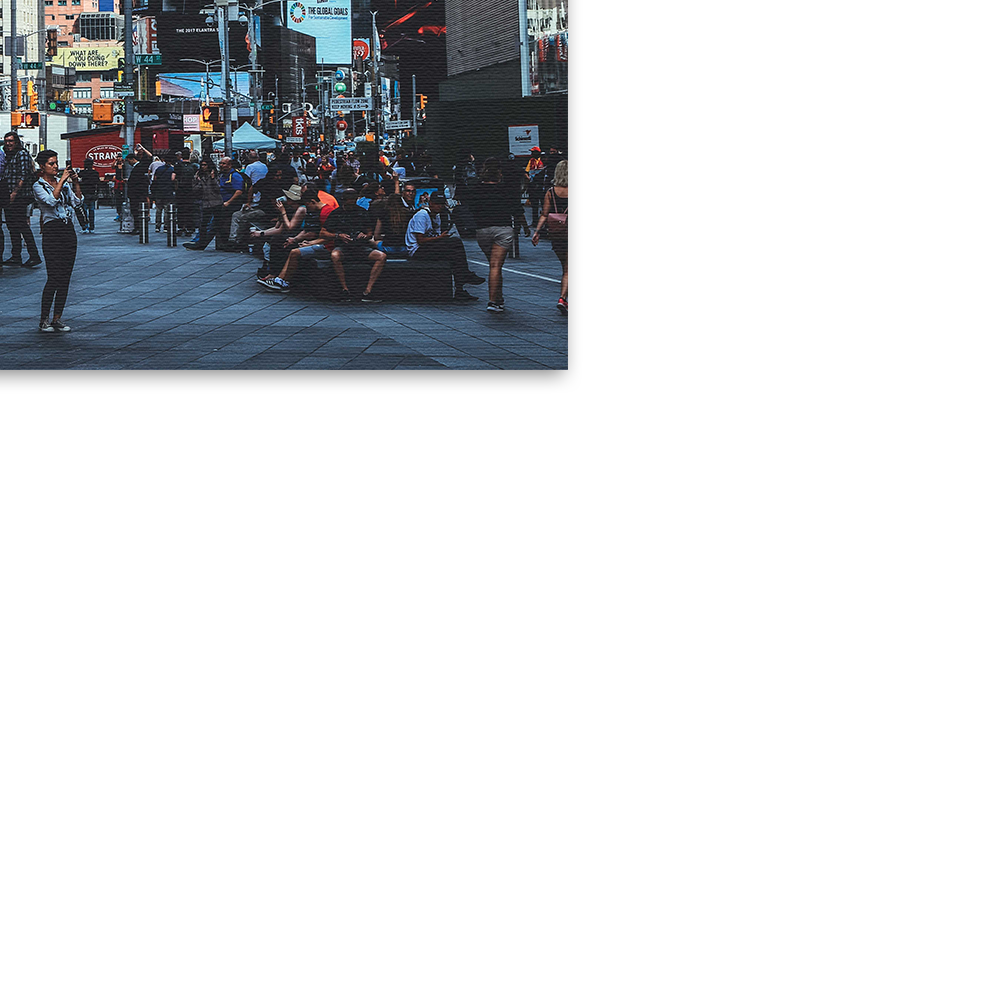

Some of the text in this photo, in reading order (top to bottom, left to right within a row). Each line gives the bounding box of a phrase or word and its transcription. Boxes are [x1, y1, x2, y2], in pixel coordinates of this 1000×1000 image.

[308, 7, 348, 16] THE GLOBAL GOALS
[136, 55, 142, 63] W
[144, 55, 154, 64] 44
[295, 117, 304, 135] tkts
